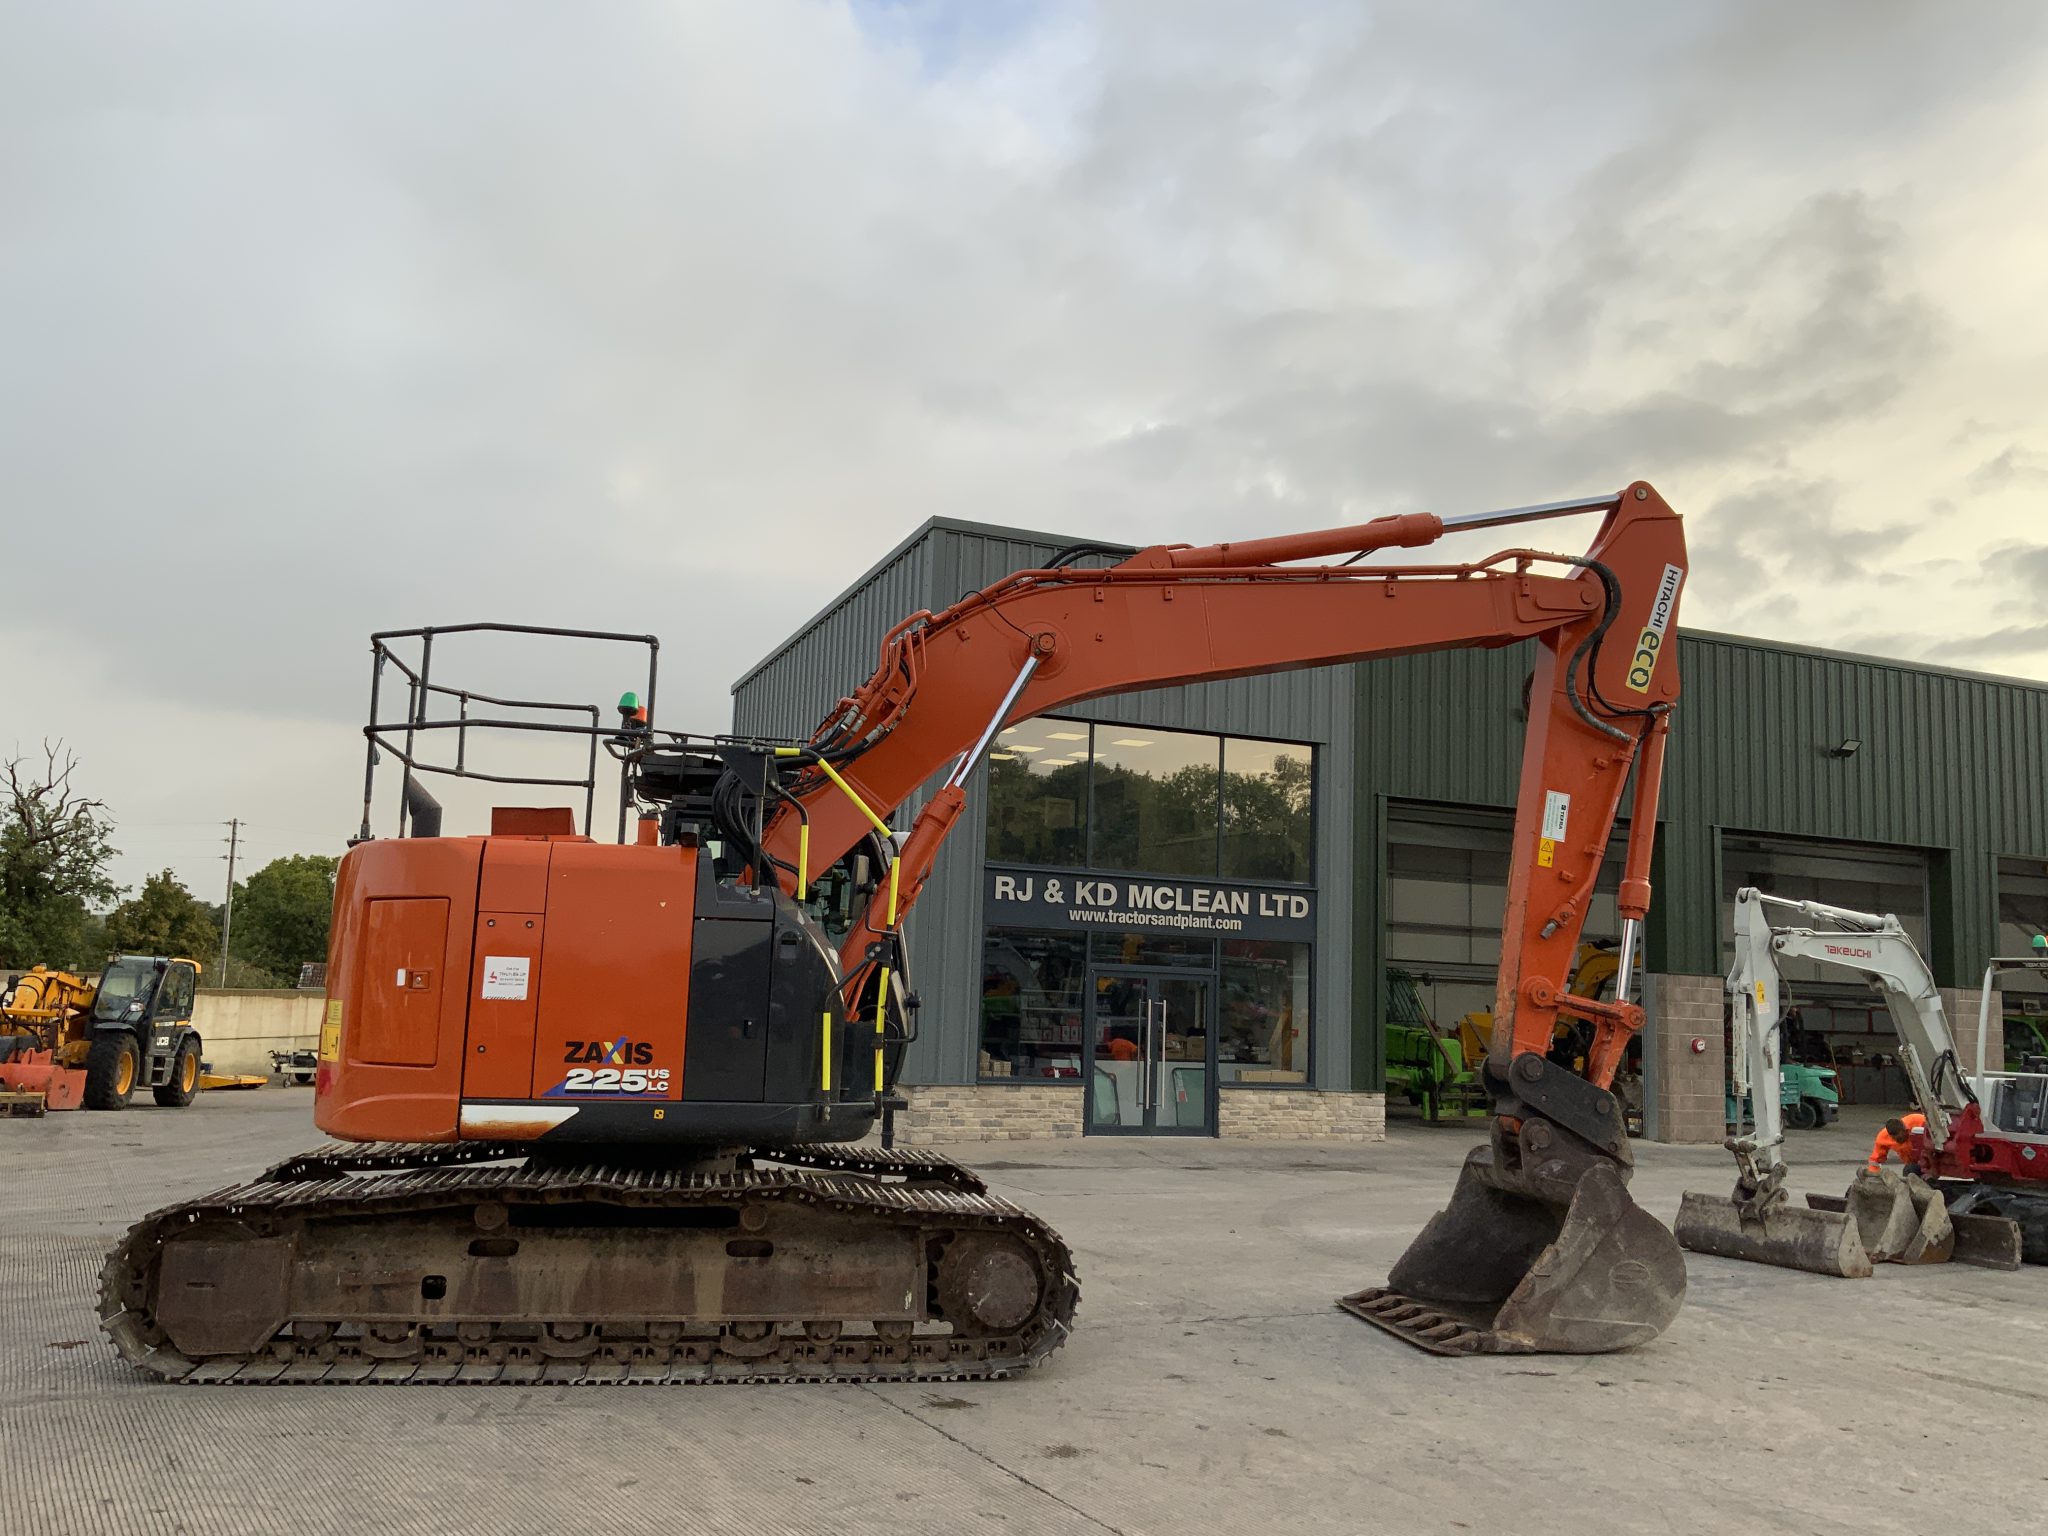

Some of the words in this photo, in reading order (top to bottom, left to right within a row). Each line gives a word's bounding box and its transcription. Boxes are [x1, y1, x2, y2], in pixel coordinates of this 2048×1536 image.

[1652, 569, 1678, 629] HITACHI
[1630, 631, 1660, 687] eco
[994, 874, 1034, 902] RJ
[1043, 878, 1065, 904] &
[1075, 881, 1118, 907] KD
[1127, 884, 1250, 915] MCLEAN
[1259, 893, 1310, 919] LTD
[1069, 909, 1242, 931] www.tractorsandplant.com
[156, 1036, 170, 1046] JCB
[564, 1036, 654, 1064] ZAXIS
[563, 1067, 648, 1094] 225
[648, 1068, 670, 1080] US
[648, 1081, 670, 1092] LC
